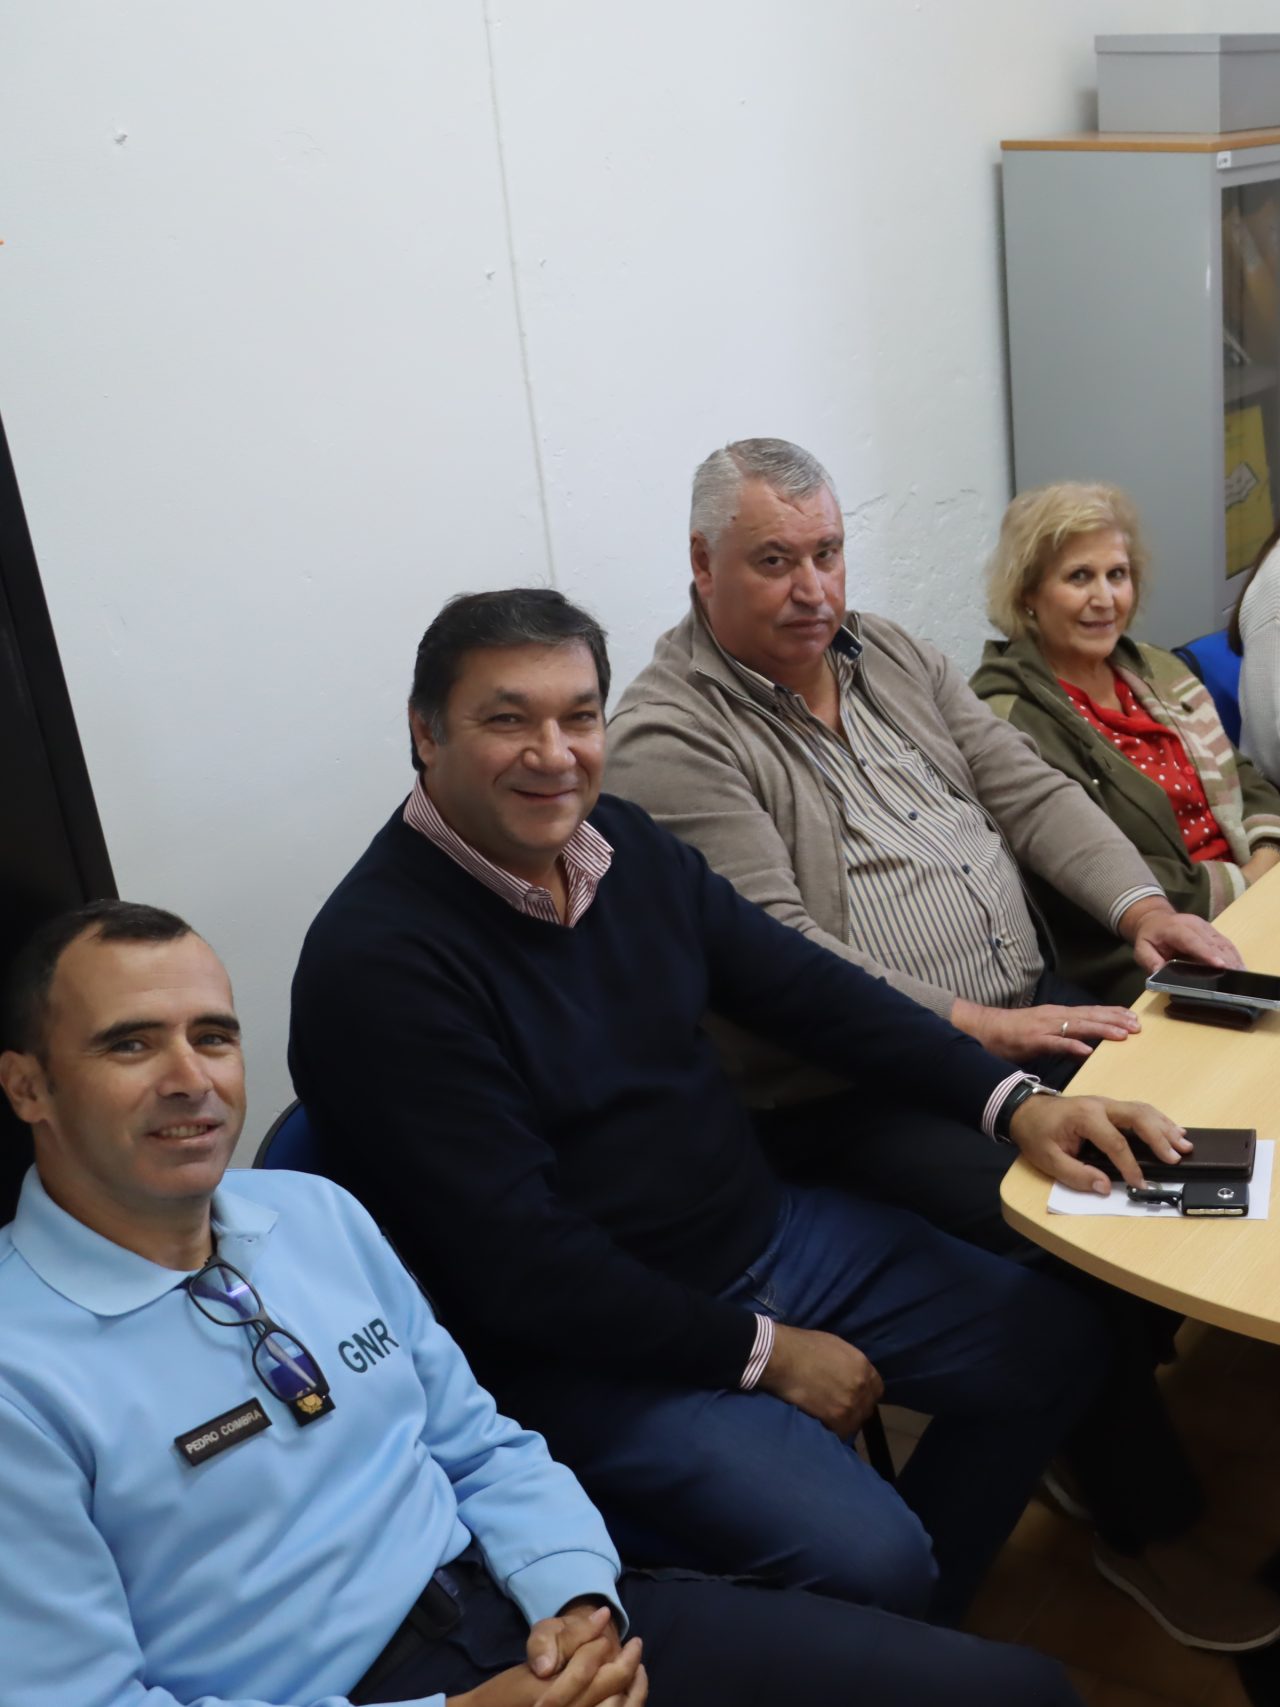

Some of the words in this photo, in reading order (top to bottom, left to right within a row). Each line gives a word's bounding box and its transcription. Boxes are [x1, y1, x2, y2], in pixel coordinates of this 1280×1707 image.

[338, 1318, 399, 1373] GNR
[185, 1431, 219, 1454] PEDRO
[220, 1410, 262, 1435] COIMBRA
